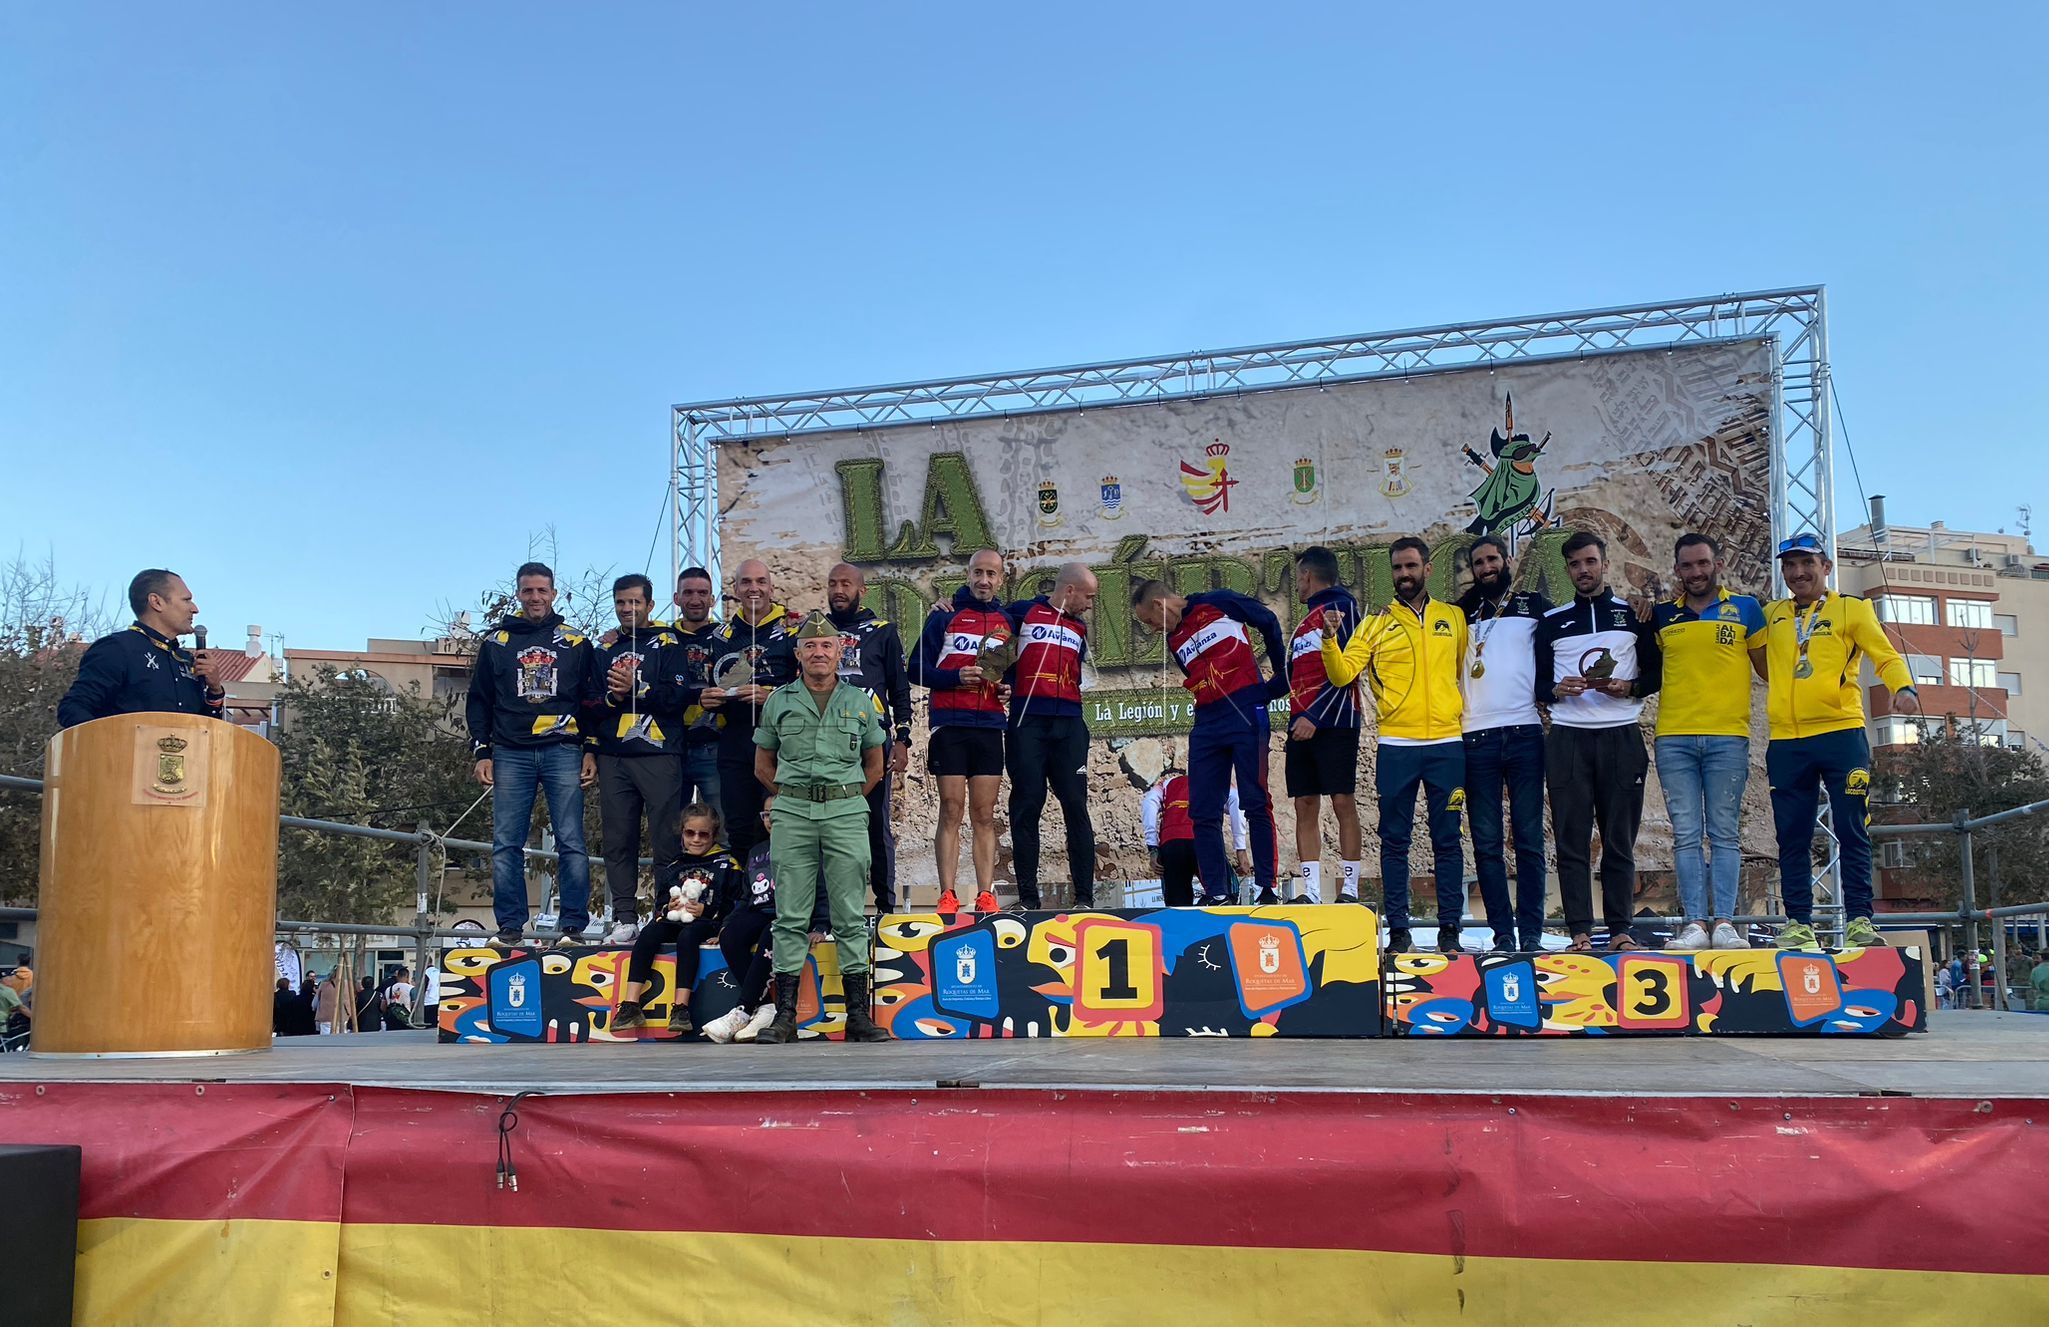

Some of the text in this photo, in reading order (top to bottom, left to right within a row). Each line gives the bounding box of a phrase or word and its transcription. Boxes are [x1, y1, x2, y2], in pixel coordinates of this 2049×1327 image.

[833, 450, 1000, 563] LA
[1186, 632, 1217, 656] Avanza
[1720, 637, 1734, 646] DA
[1095, 703, 1112, 721] La
[1118, 701, 1163, 722] Legión
[1170, 704, 1179, 721] y
[1186, 702, 1195, 717] e
[1096, 939, 1138, 999] 1
[1633, 968, 1671, 1016] 3
[639, 968, 667, 1019] 2
